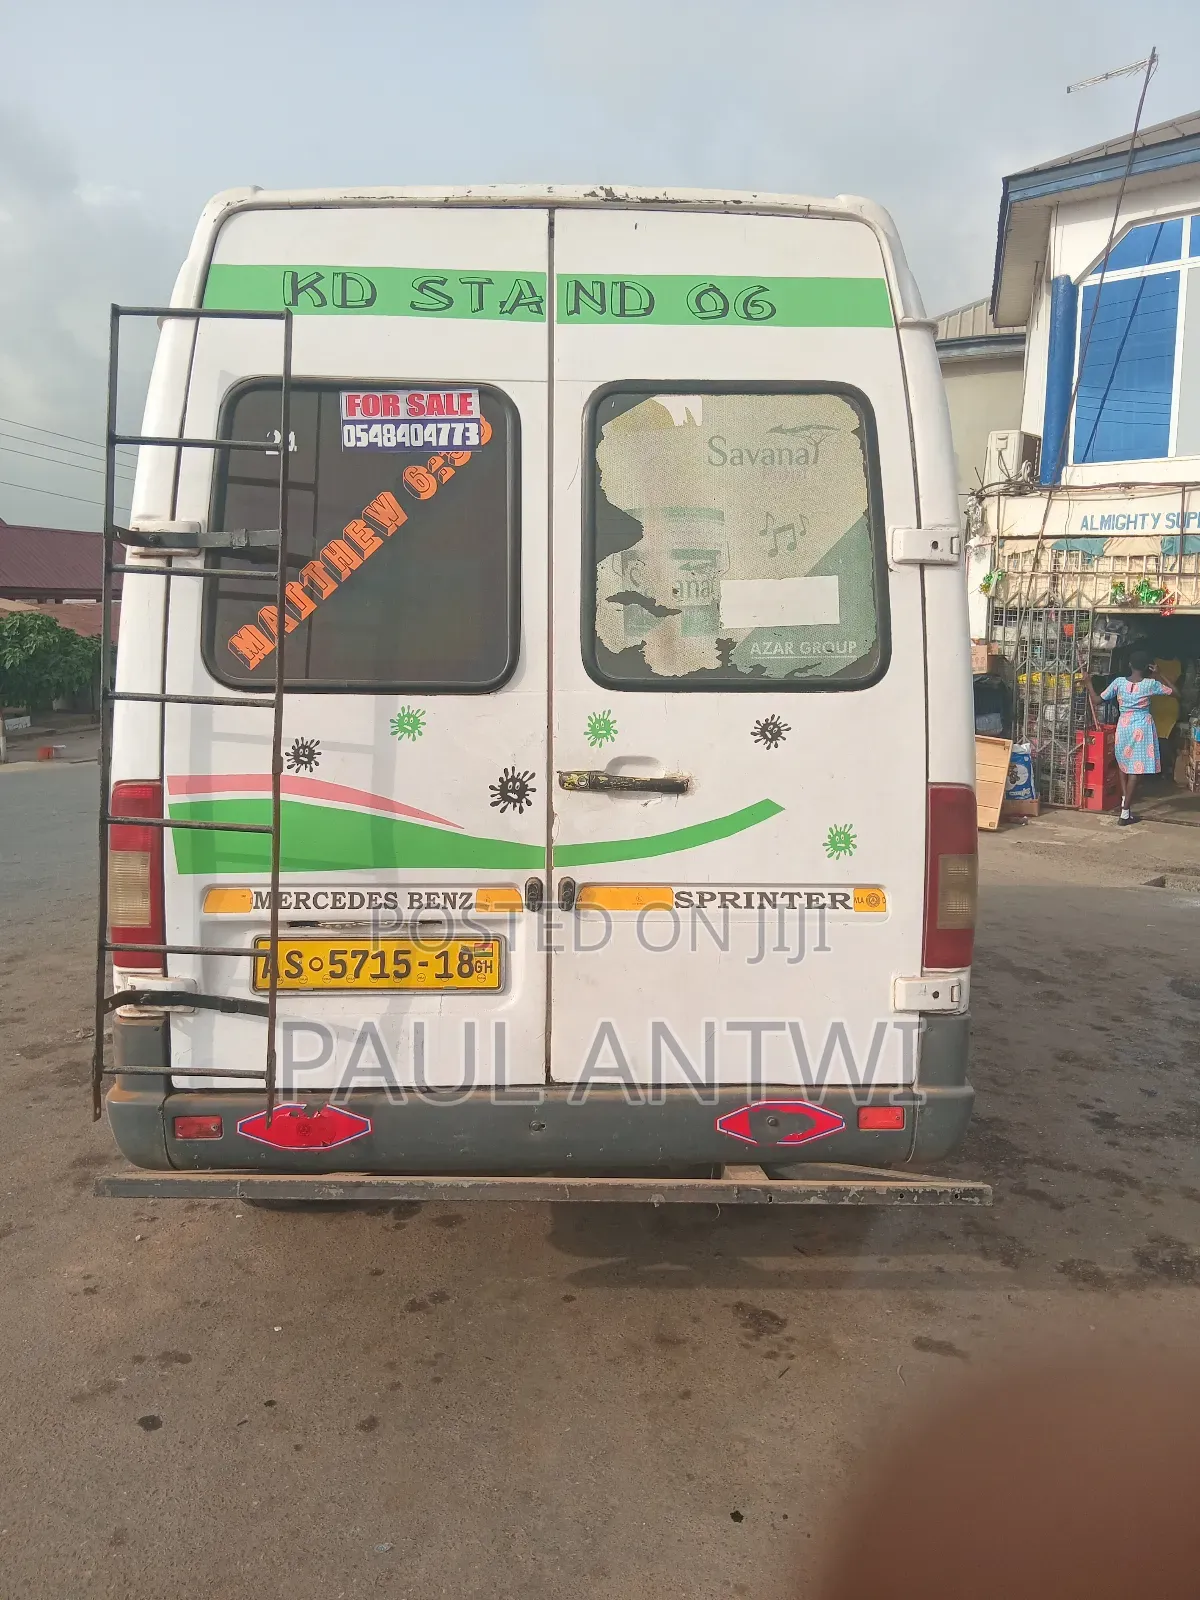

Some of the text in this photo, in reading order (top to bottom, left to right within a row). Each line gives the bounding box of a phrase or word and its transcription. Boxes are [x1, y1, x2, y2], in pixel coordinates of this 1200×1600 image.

[283, 271, 377, 308] KD
[686, 282, 776, 321] 06
[346, 392, 474, 417] FOR SALE
[343, 422, 480, 447] 0548404773
[1080, 512, 1162, 531] ALMIGHTY
[228, 491, 409, 671] MATTHEW
[751, 641, 857, 655] AZAR GROUP
[252, 890, 473, 911] MERCEDES BENZ
[674, 890, 853, 911] SPRINTER
